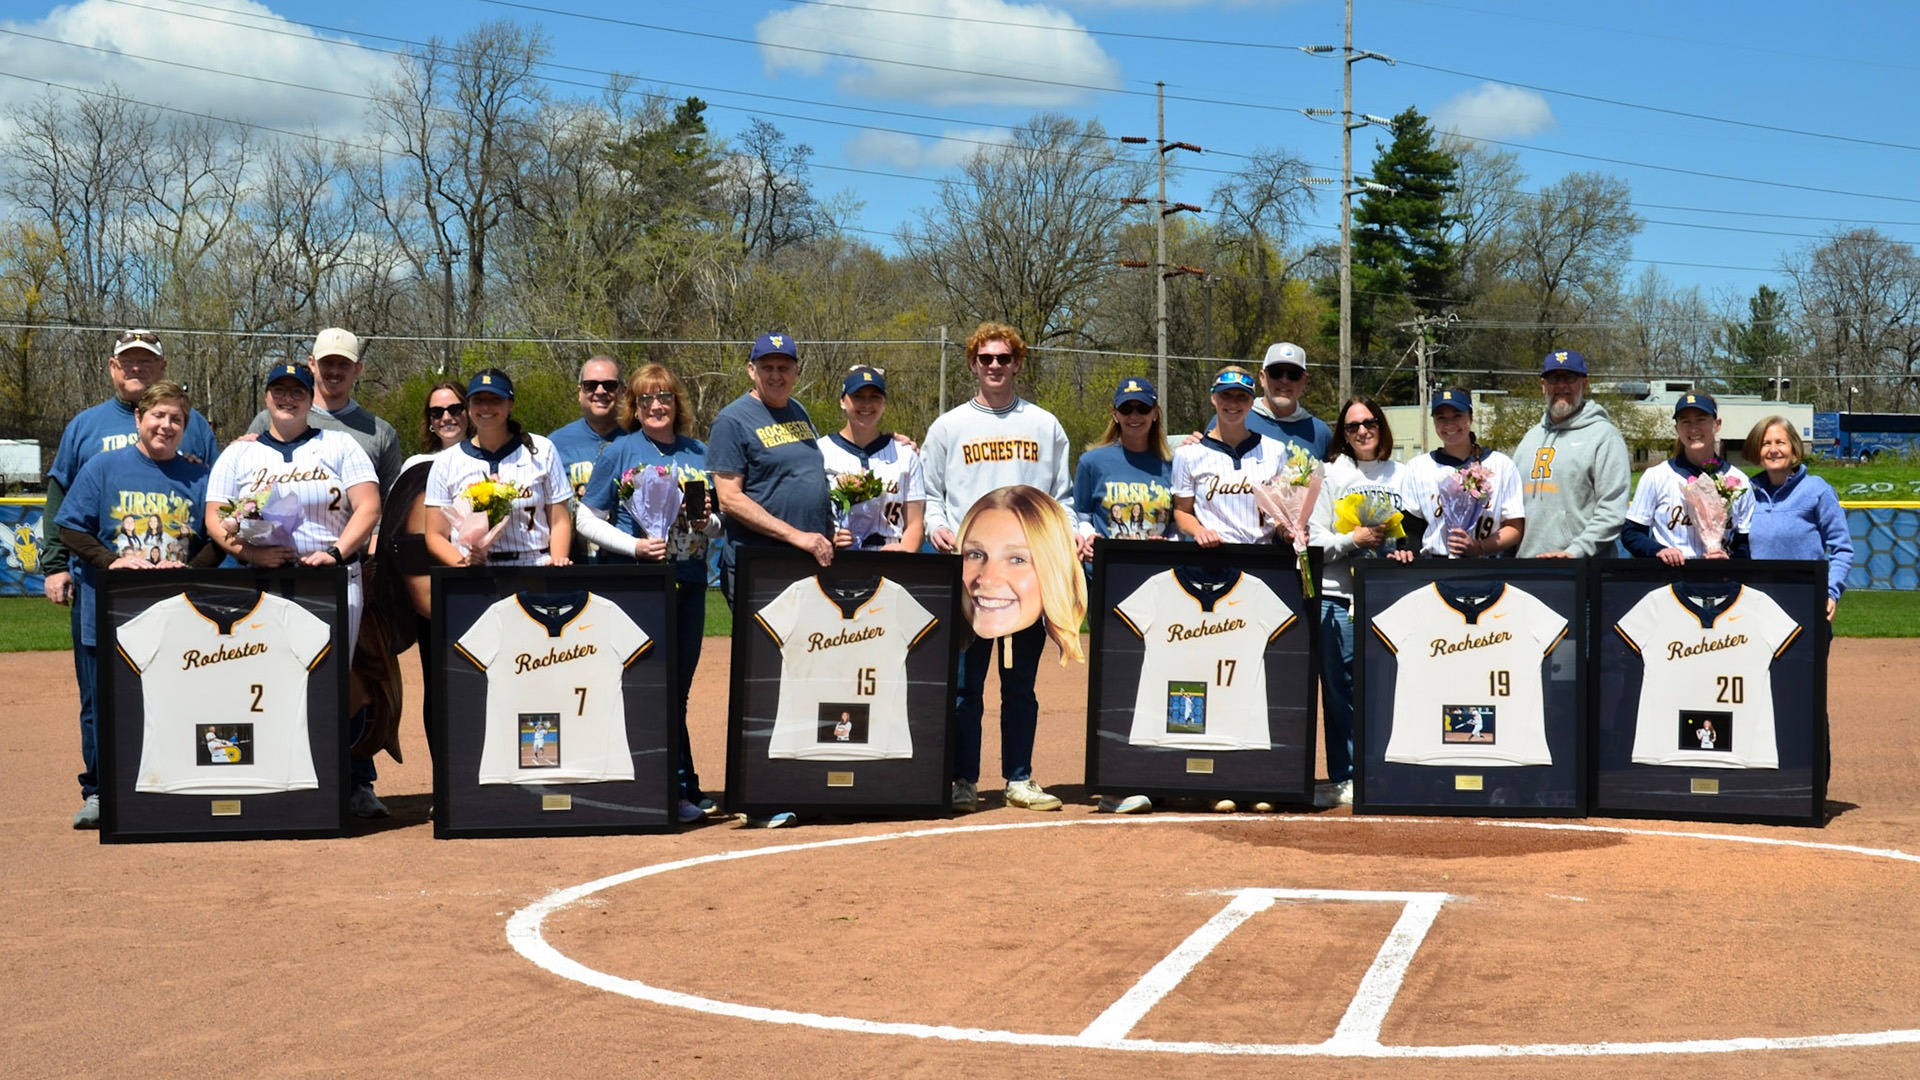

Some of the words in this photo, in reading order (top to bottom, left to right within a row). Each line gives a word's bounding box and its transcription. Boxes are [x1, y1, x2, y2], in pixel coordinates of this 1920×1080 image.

[286, 366, 296, 375] R
[482, 375, 492, 385] R
[863, 372, 873, 381] R
[1443, 391, 1452, 400] R
[1687, 395, 1696, 404] R
[962, 439, 1039, 465] ROCHESTER
[1531, 446, 1556, 480] R
[250, 467, 330, 493] 'Jackets
[1105, 481, 1149, 504] URSB
[1848, 482, 1894, 495] 20
[328, 486, 342, 511] 2
[524, 506, 536, 530] 7
[884, 502, 901, 525] 15
[807, 625, 886, 653] Rochester
[1167, 617, 1247, 643] Rochester
[182, 641, 268, 671] Rochester
[1429, 630, 1513, 658] Rochester
[1666, 633, 1749, 661] Rochester
[514, 643, 597, 675] Rochester
[857, 667, 877, 696] 15
[1216, 659, 1237, 687] 17
[1489, 670, 1511, 697] 19
[250, 684, 264, 713] 2
[574, 687, 588, 717] 7
[1716, 676, 1744, 704] 20
